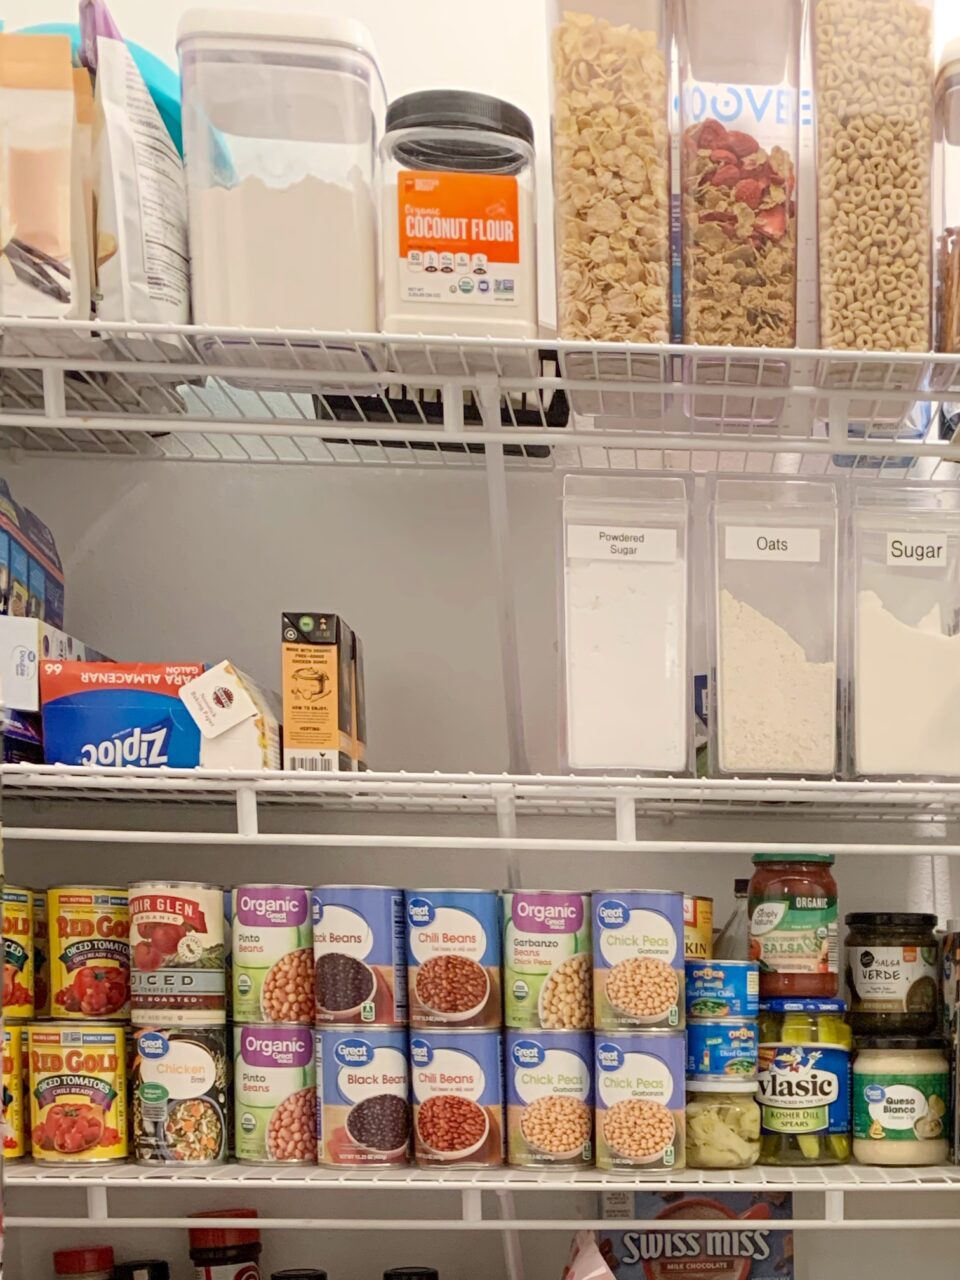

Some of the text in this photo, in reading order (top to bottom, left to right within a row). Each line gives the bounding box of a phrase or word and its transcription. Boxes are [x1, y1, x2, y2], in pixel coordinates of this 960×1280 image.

[406, 216, 514, 242] COCONUT FLOUR
[599, 531, 645, 543] Powdered
[757, 536, 788, 551] Oats
[610, 544, 637, 556] Sugar
[891, 540, 943, 561] Sugar
[44, 664, 62, 675] 66
[81, 672, 160, 684] ALMACENAR
[81, 727, 168, 767] Ziploc
[156, 899, 194, 917] GLEN
[240, 896, 299, 915] Organic
[796, 897, 828, 909] ORGANIC
[517, 902, 576, 921] Organic
[599, 907, 624, 918] Great
[757, 907, 778, 919] Simply
[135, 914, 179, 923] ORGANIC
[754, 918, 775, 927] Nature
[57, 915, 95, 939] RED
[238, 934, 260, 943] Pinto
[330, 933, 362, 943] Beans
[418, 933, 477, 943] Chili Beans
[513, 938, 559, 948] Garbanzo
[606, 935, 669, 946] Chick Peas
[66, 941, 92, 956] DICED
[238, 944, 264, 953] Beans
[513, 949, 540, 957] Beans
[763, 943, 805, 954] SALSA
[875, 958, 901, 968] SALSA
[862, 969, 901, 981] VERDE
[140, 1039, 163, 1048] Great
[246, 1036, 305, 1055] Organic
[338, 1045, 367, 1056] Great
[514, 1046, 538, 1057] Great
[598, 1050, 618, 1060] Great
[31, 1049, 119, 1074] RED GOLD
[345, 1054, 368, 1062] Value
[156, 1064, 205, 1074] Chicken
[243, 1074, 266, 1083] Pinto
[347, 1074, 379, 1085] Black
[418, 1073, 474, 1084] Chili Beans
[521, 1074, 583, 1085] Chick Peas
[603, 1077, 664, 1088] Chick Peas
[39, 1076, 110, 1093] DICED TOMATOES
[243, 1084, 270, 1092] Beans
[52, 1087, 94, 1096] CHILI READY
[886, 1097, 916, 1107] Queso
[771, 1111, 819, 1119] KOSHER DILL
[622, 1230, 770, 1264] SWISS MISS
[667, 1262, 728, 1271] MILK CHOCOLATE
